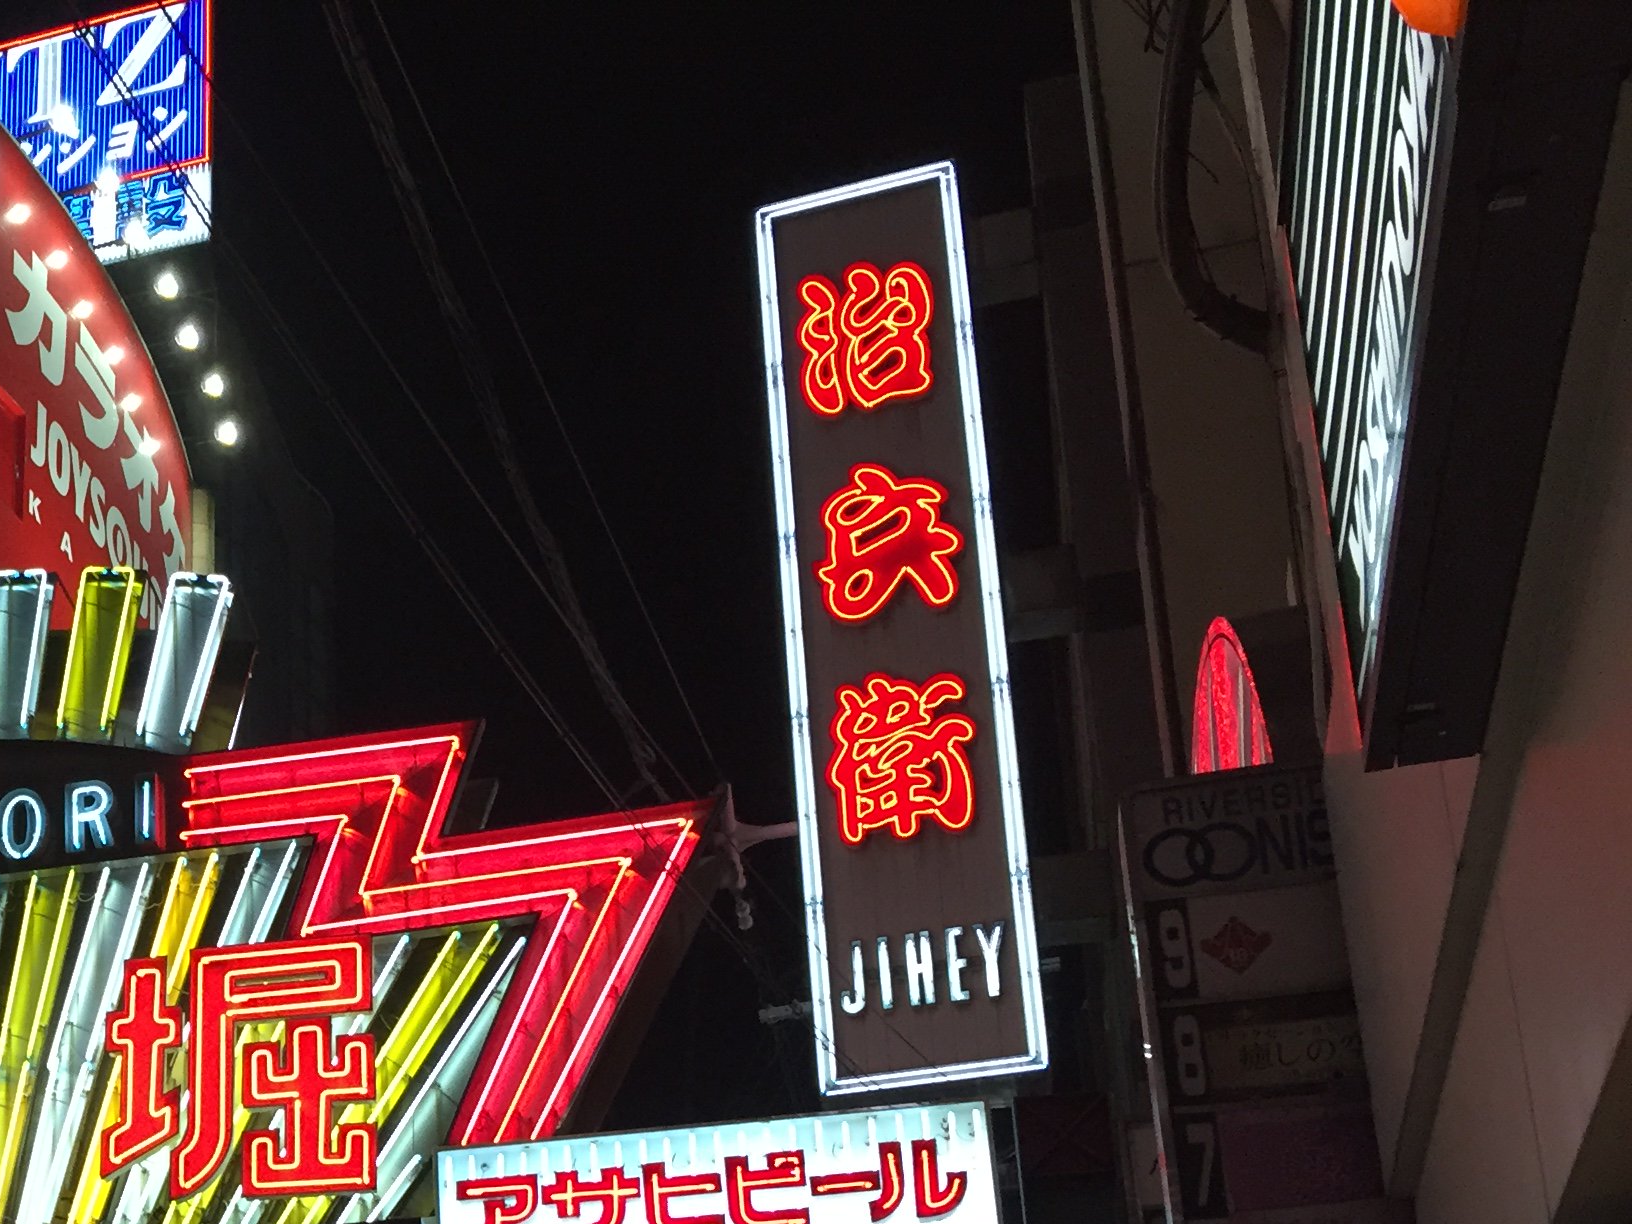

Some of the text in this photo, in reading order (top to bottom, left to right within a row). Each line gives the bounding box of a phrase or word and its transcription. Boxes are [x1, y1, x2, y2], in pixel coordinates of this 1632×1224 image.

[840, 922, 1005, 1015] JIHEY
[1172, 1014, 1208, 1097] 8
[1185, 1122, 1216, 1207] 7
